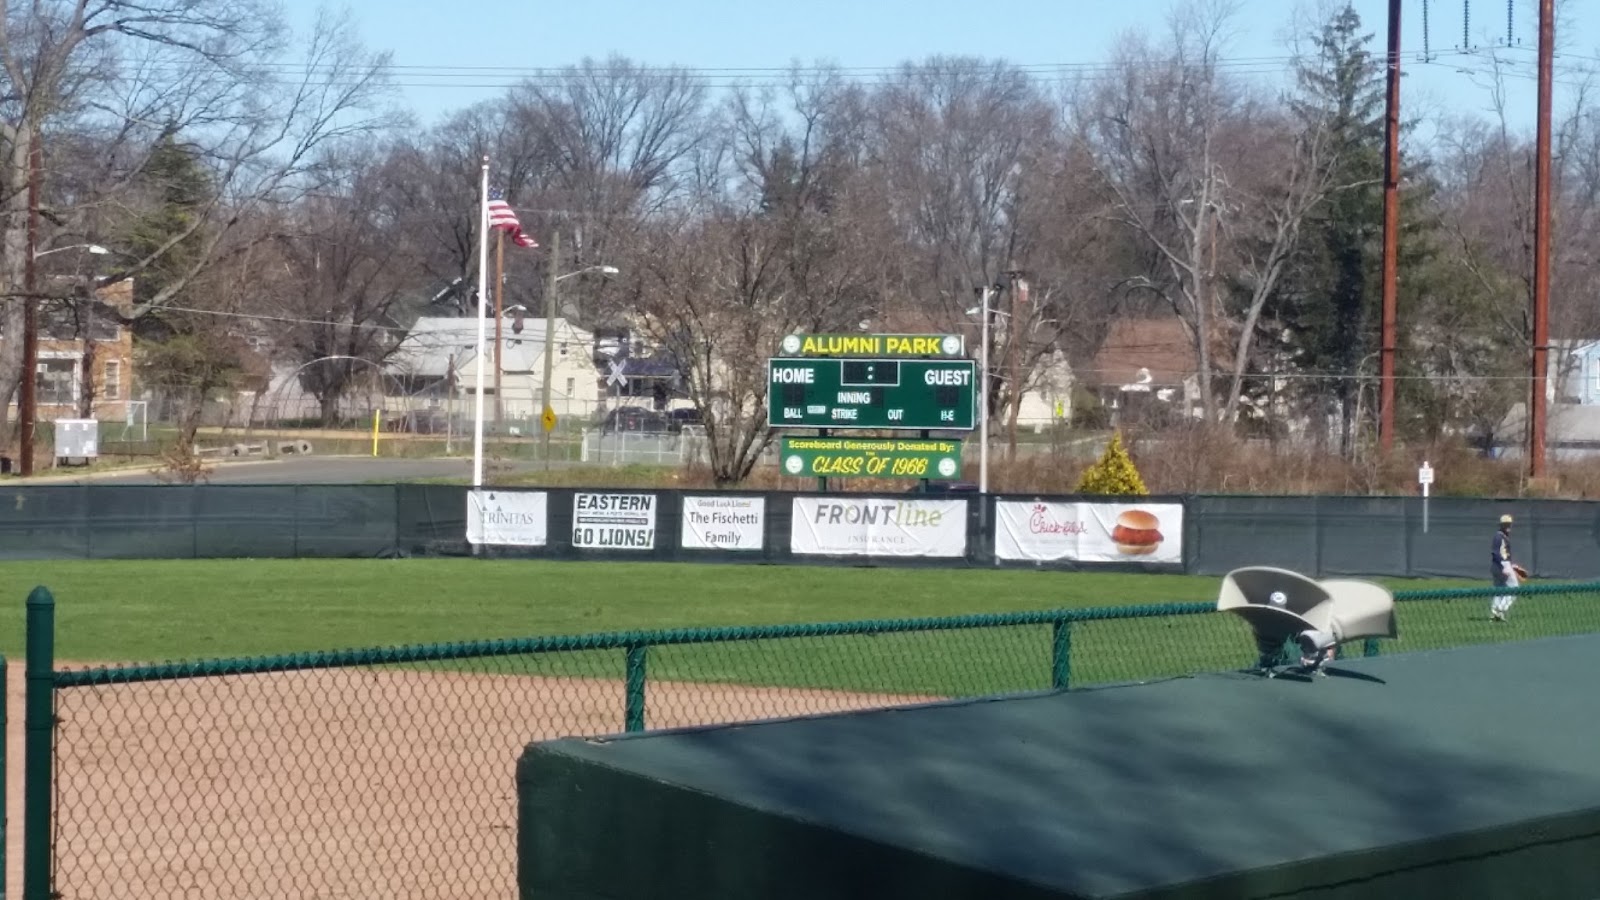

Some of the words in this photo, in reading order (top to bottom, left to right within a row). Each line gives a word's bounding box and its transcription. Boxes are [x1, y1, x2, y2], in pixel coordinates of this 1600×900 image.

[802, 337, 880, 353] ALUMNI
[886, 338, 941, 354] PARK
[773, 368, 815, 384] HOME
[924, 369, 971, 386] GUEST
[837, 392, 871, 404] INNING
[783, 407, 803, 418] BALL
[831, 408, 858, 419] STRIKE
[887, 409, 904, 420] OUT
[789, 440, 842, 449] Scoreboard
[843, 441, 895, 451] Generously
[897, 442, 937, 451] Donated
[939, 443, 955, 453] By:
[812, 456, 864, 474] CLASS
[866, 457, 890, 474] OF
[891, 458, 929, 475] 1966
[577, 495, 652, 511] EASTERN
[481, 511, 534, 525] TRINITAS
[689, 512, 710, 524] The
[712, 512, 758, 524] Fischetti
[574, 528, 594, 545] GO
[598, 528, 654, 547] LIONS!
[705, 531, 741, 546] Family
[848, 535, 905, 544] INSURANCE
